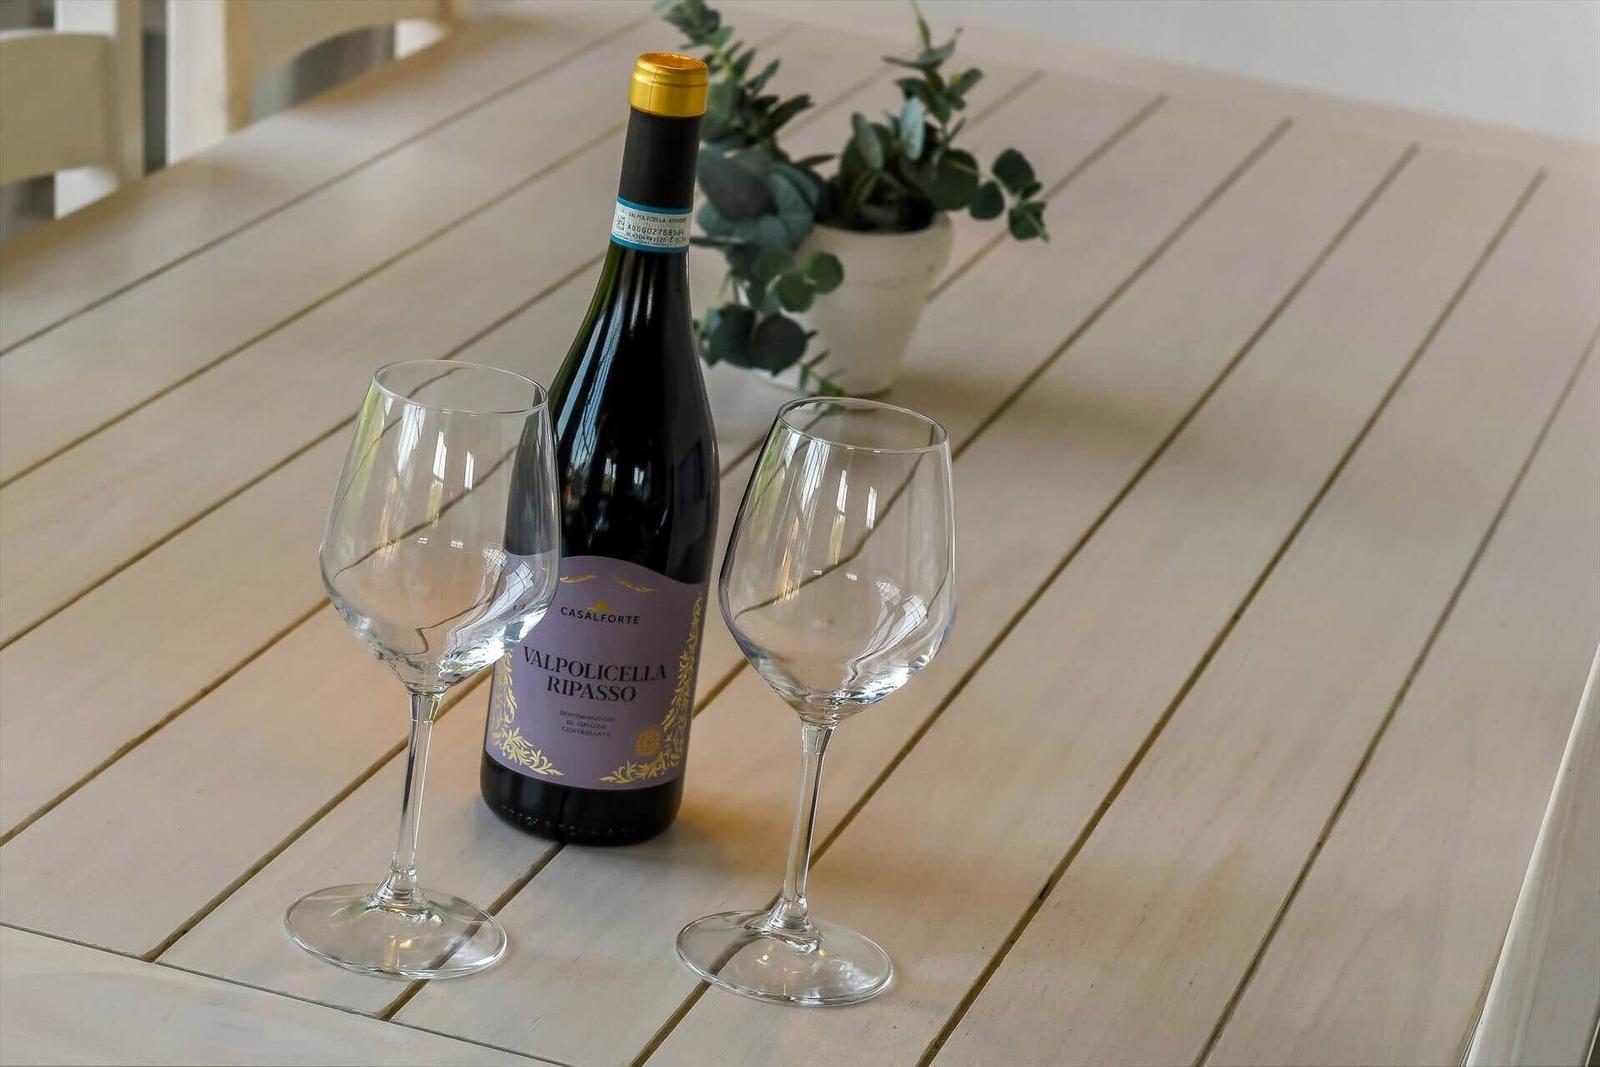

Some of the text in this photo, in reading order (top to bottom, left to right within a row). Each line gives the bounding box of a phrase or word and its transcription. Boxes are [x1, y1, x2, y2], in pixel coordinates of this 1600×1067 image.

[560, 606, 641, 625] CASALFORTE
[523, 645, 667, 682] VALPOLICELLA
[546, 675, 637, 703] RIPASSO
